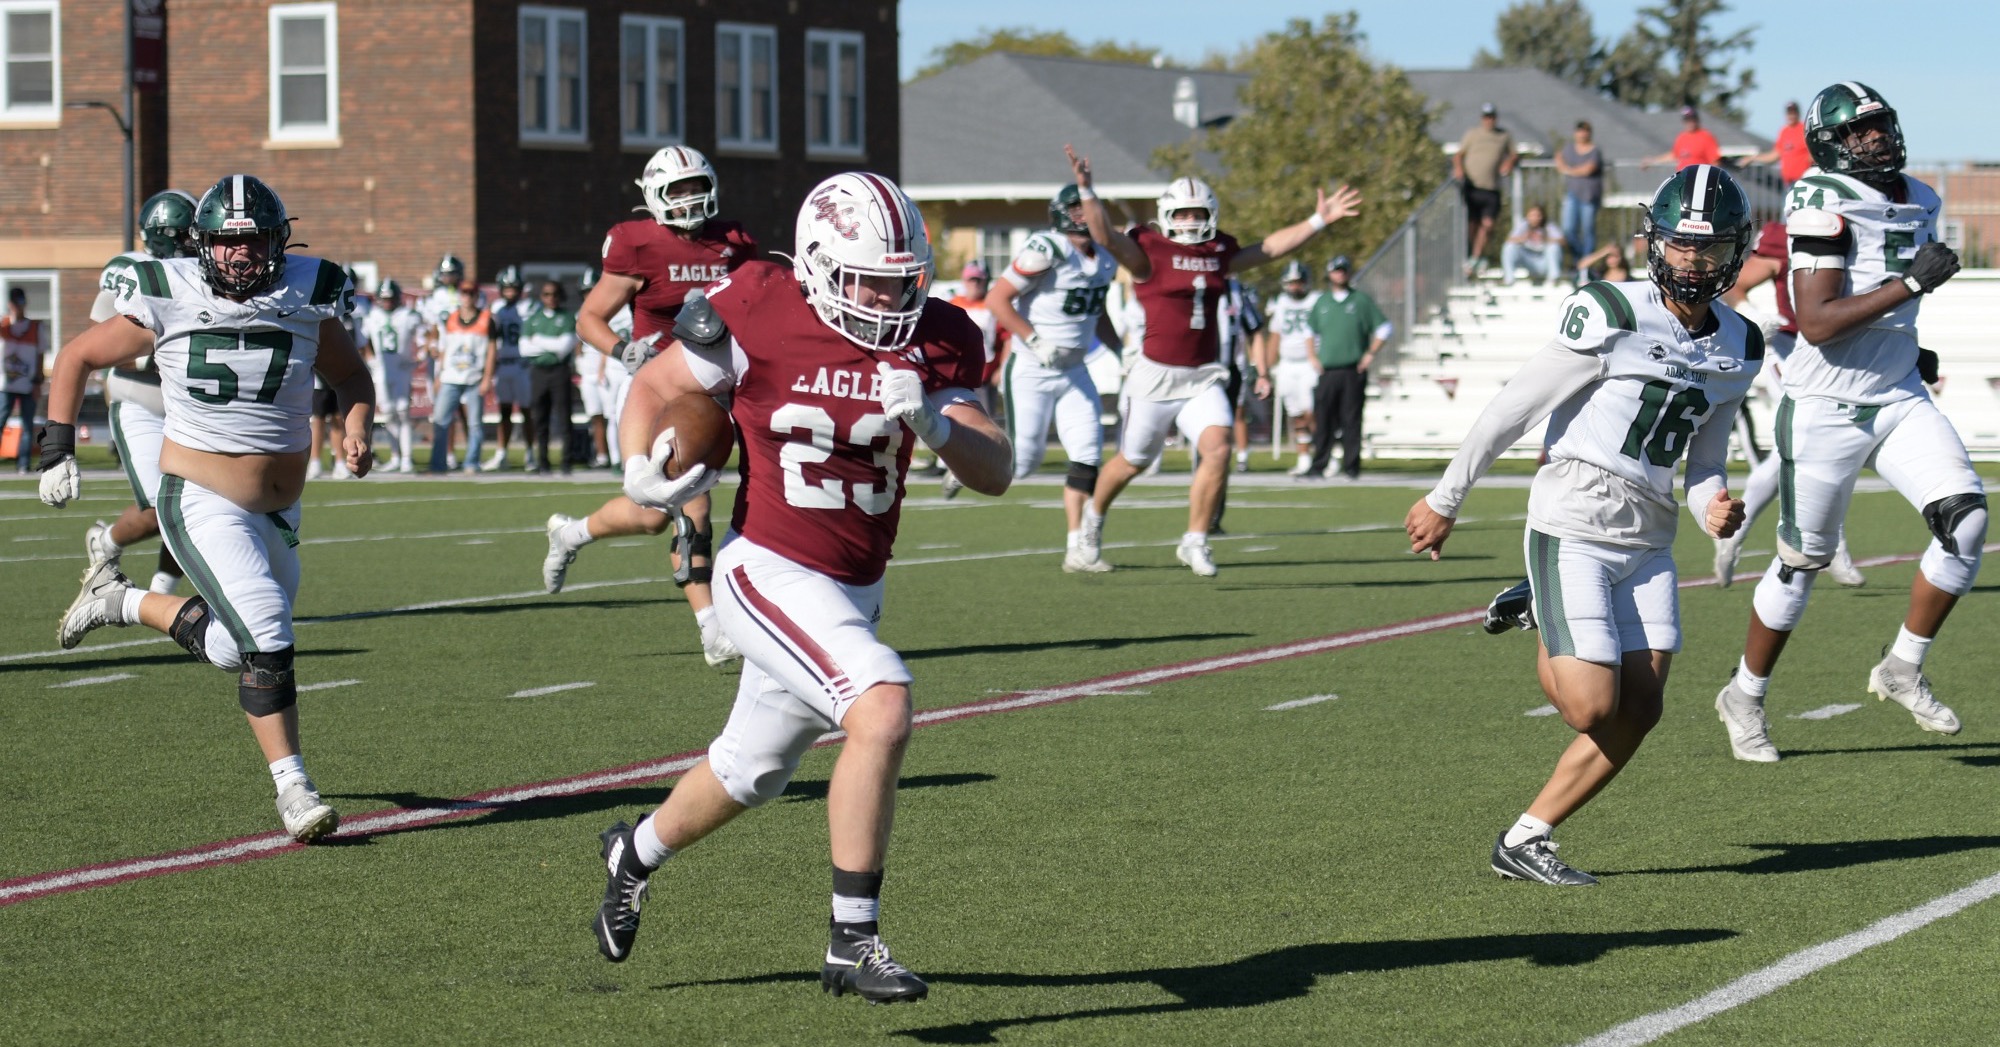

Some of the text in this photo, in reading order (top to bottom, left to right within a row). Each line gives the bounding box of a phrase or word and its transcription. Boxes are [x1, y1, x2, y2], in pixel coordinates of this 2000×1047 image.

[1791, 186, 1825, 211] 54
[1681, 222, 1710, 231] Riddell
[668, 264, 728, 281] EAGLES
[884, 256, 914, 265] Riddell
[1172, 255, 1220, 271] EAGLES
[1190, 275, 1206, 330] 1
[1559, 301, 1589, 340] 16
[187, 331, 293, 405] 57
[791, 366, 885, 402] EAGLE
[1664, 366, 1688, 380] ADAMS
[1620, 380, 1710, 468] 16
[770, 402, 904, 515] 23
[607, 836, 625, 878] NIKE
